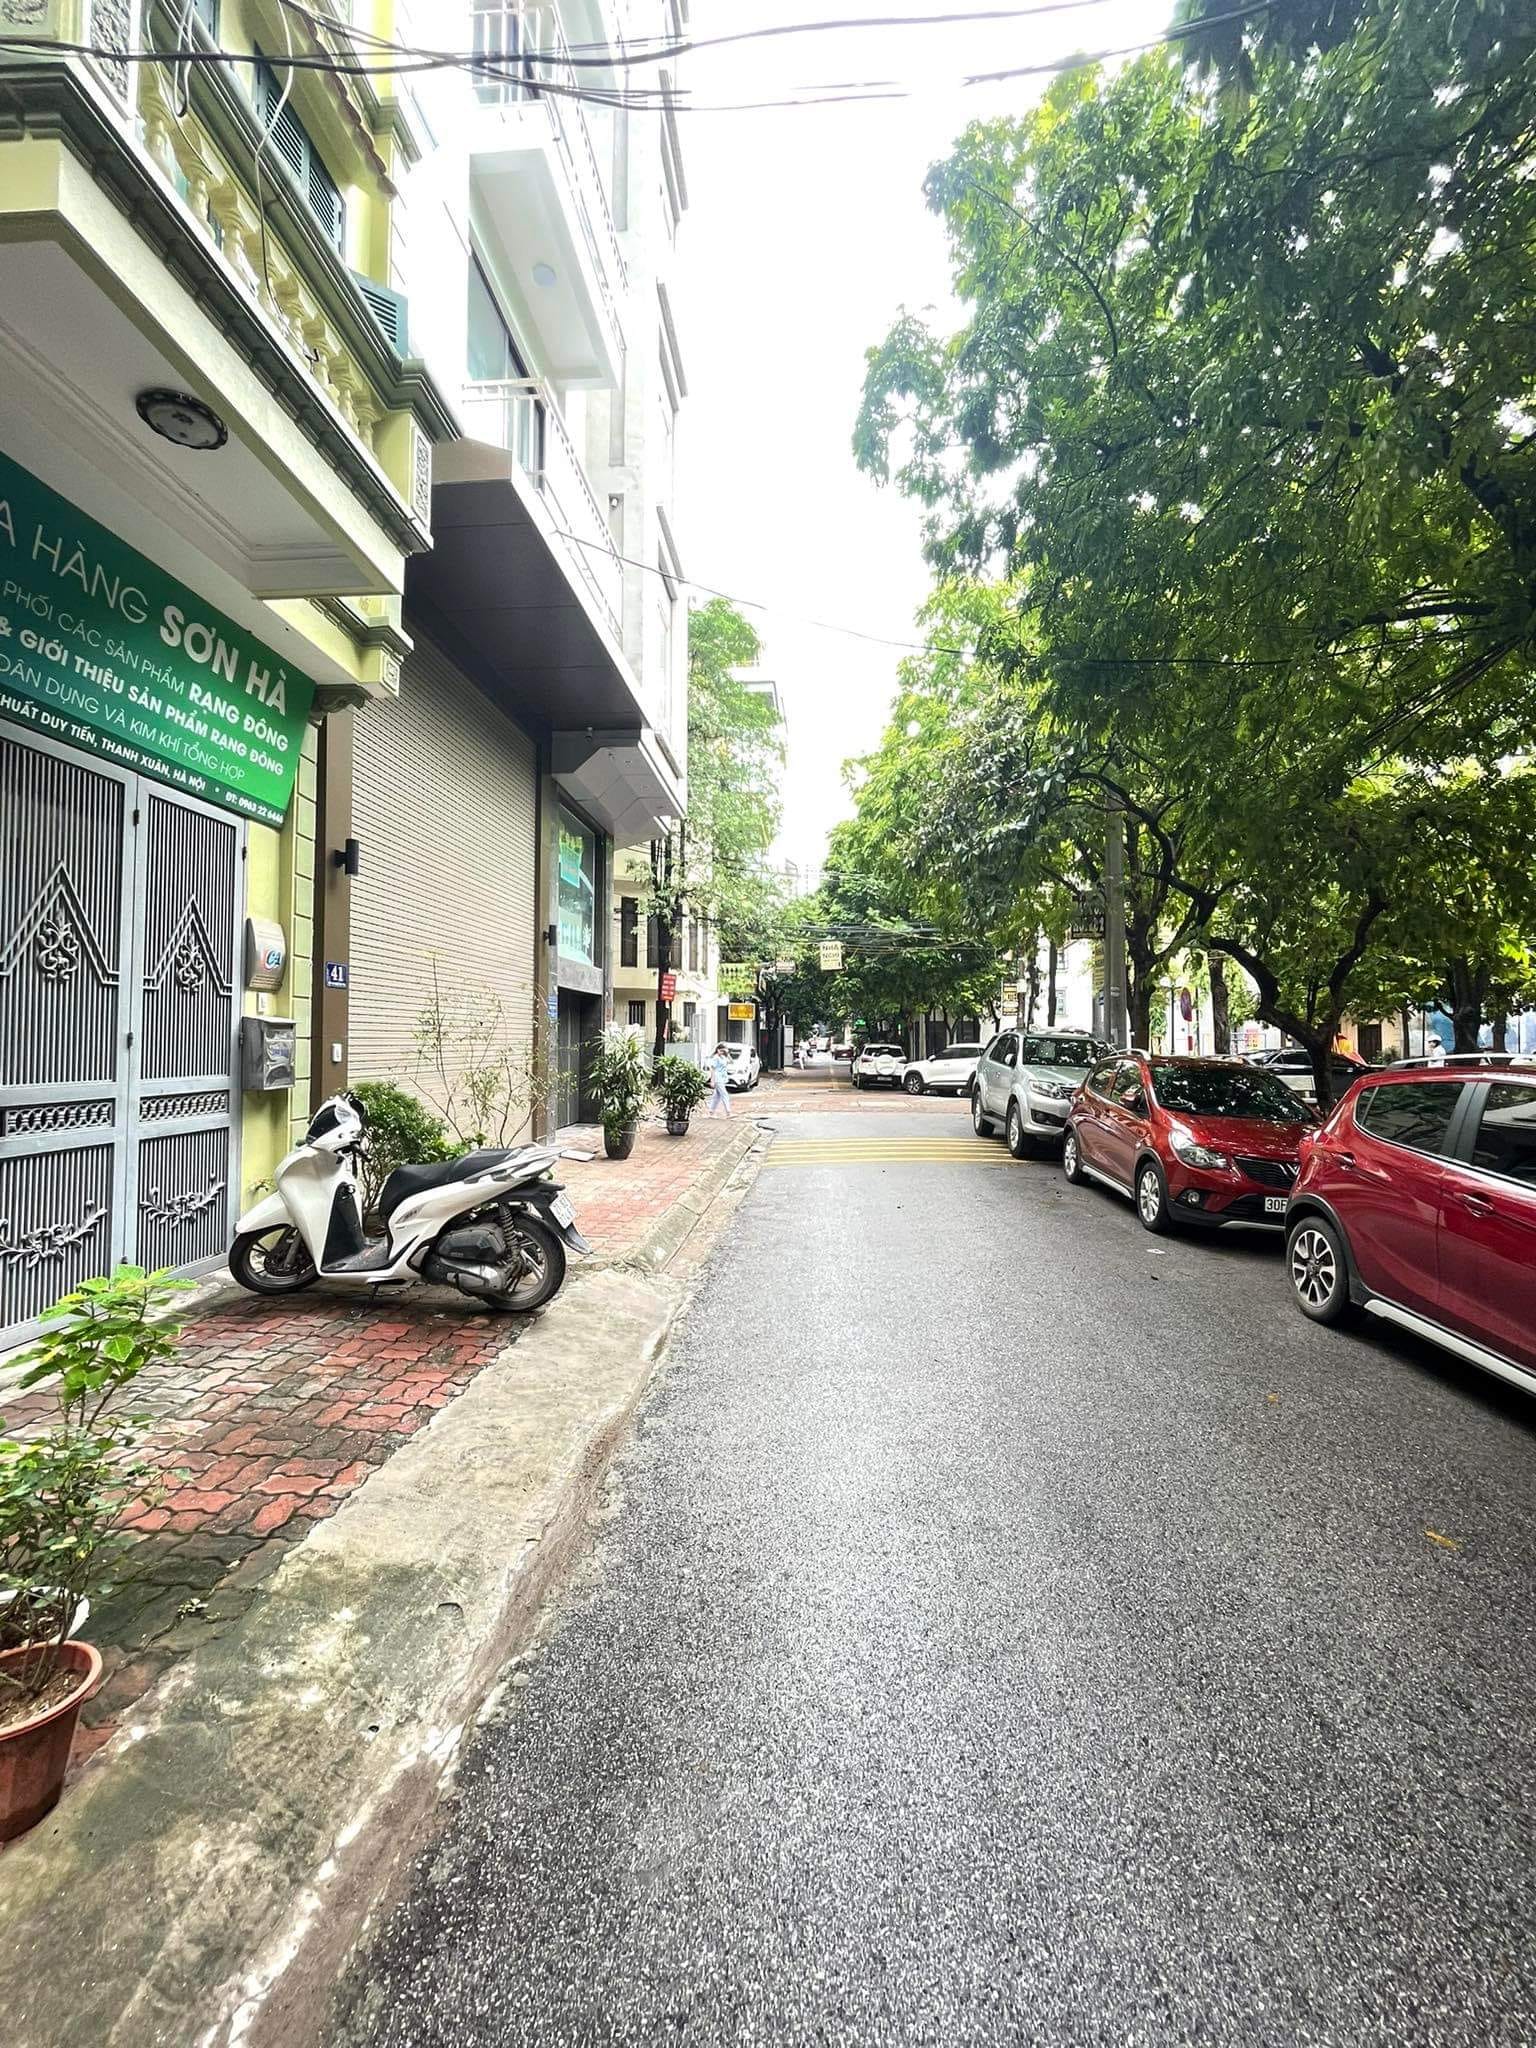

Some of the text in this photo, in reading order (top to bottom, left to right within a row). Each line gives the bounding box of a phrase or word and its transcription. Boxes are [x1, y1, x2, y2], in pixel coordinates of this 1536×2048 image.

[3, 580, 288, 752] PHỐI CÁC SẢN PHẨM RẠNG ĐÔNG
[32, 524, 149, 624] HÀNG
[160, 605, 239, 683] SƠN
[245, 660, 287, 716] HÀ
[0, 653, 246, 781] DÂN DỤNG VÀ KIM KHÍ TỔNG HỢP
[0, 692, 40, 719] HUẤT
[40, 711, 68, 732] DUY
[70, 724, 98, 748] TIẾN,
[101, 737, 139, 763] THANH
[140, 754, 171, 778] XUÂN,
[172, 768, 187, 784] HÀ
[188, 774, 206, 792] NỘI
[257, 805, 268, 817] 22
[20, 629, 69, 667] GIỚI
[74, 655, 125, 693] THIỆU
[128, 685, 162, 715] SẢN
[165, 704, 209, 738] PHẨM
[210, 728, 248, 757] RẠNG
[249, 748, 284, 776] ĐÔNG
[330, 965, 344, 982] 41
[1266, 1198, 1288, 1211] 30F
